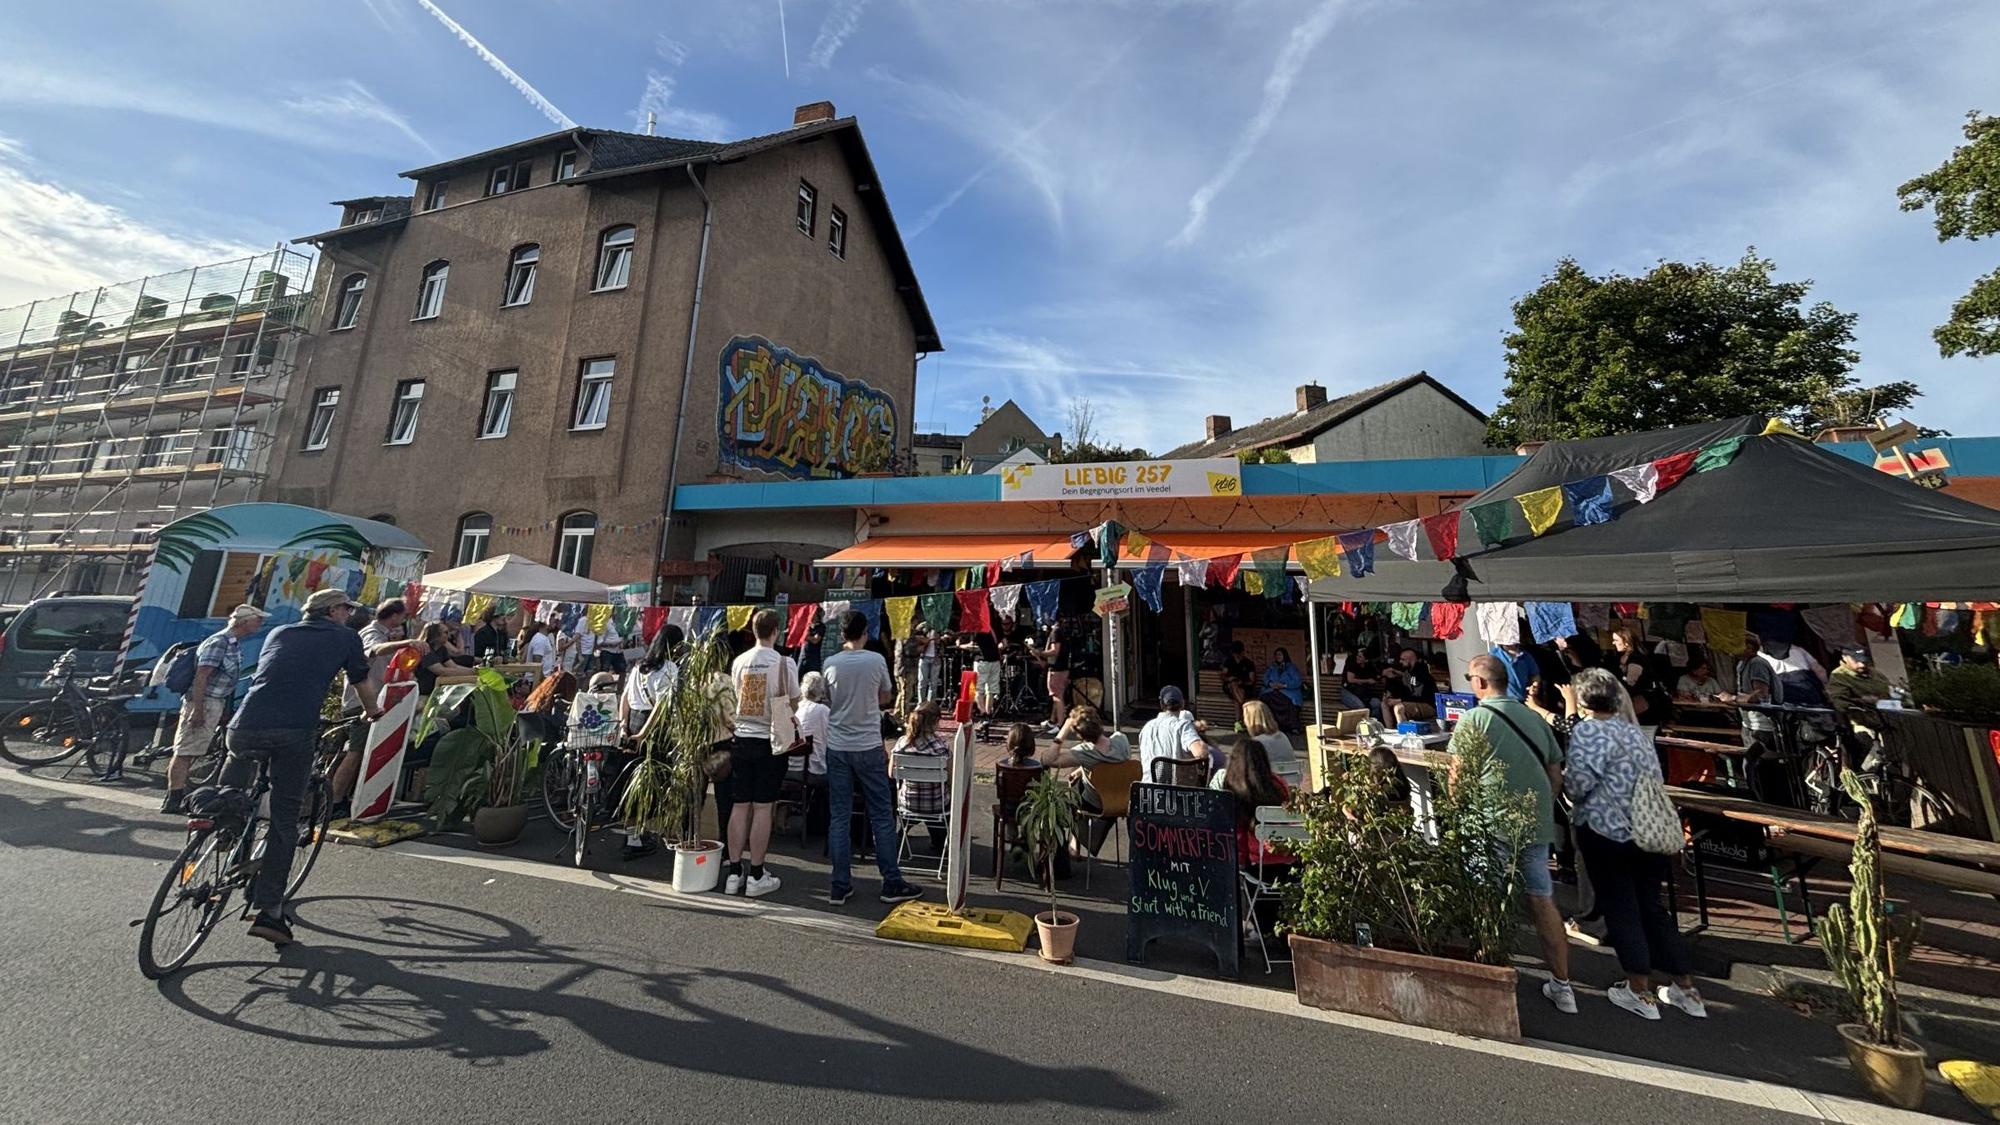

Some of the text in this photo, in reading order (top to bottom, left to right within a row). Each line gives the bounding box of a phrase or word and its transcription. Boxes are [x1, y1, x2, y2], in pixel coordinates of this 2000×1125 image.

[1064, 464, 1173, 486] LIEBIG 257
[1062, 484, 1171, 496] Dein Begegnungsort im Veedel
[1135, 820, 1234, 863] SOMMERFEST
[1170, 861, 1190, 873] MIT
[1147, 868, 1178, 901] Klug
[1131, 895, 1229, 928] Start with a Friend
